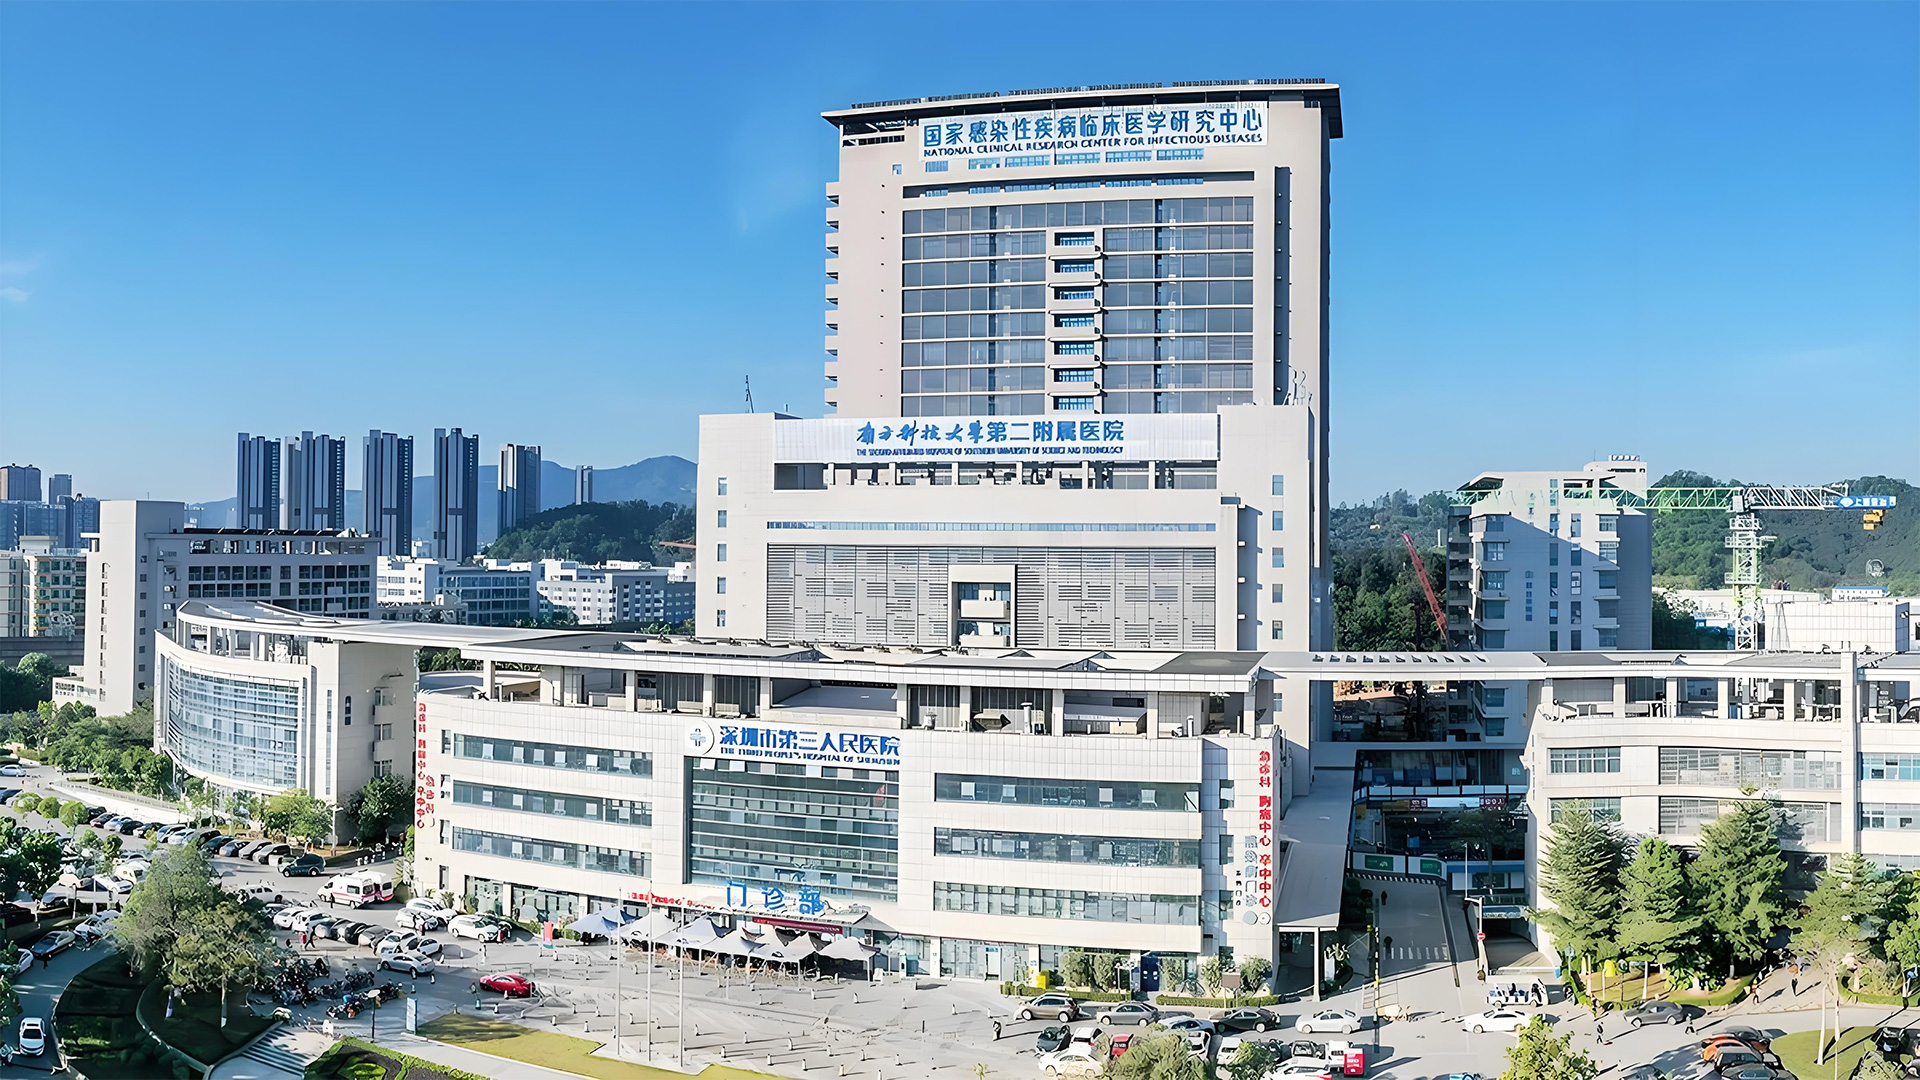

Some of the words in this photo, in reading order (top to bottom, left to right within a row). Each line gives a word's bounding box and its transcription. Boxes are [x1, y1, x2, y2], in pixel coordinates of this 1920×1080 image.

[924, 108, 1263, 147] 国家感染性疾病临床医学研究中心
[924, 148, 974, 158] NATIONAL
[977, 144, 1022, 154] CLINICAL
[1026, 140, 1078, 151] RESEARCH
[1081, 138, 1121, 148] CENTER
[1124, 137, 1145, 147] FOR
[1148, 135, 1210, 146] INFECTIOUS
[1213, 133, 1263, 144] DISEASES
[719, 725, 901, 756] 深圳市第三人民医院
[726, 879, 824, 914] 门诊部
